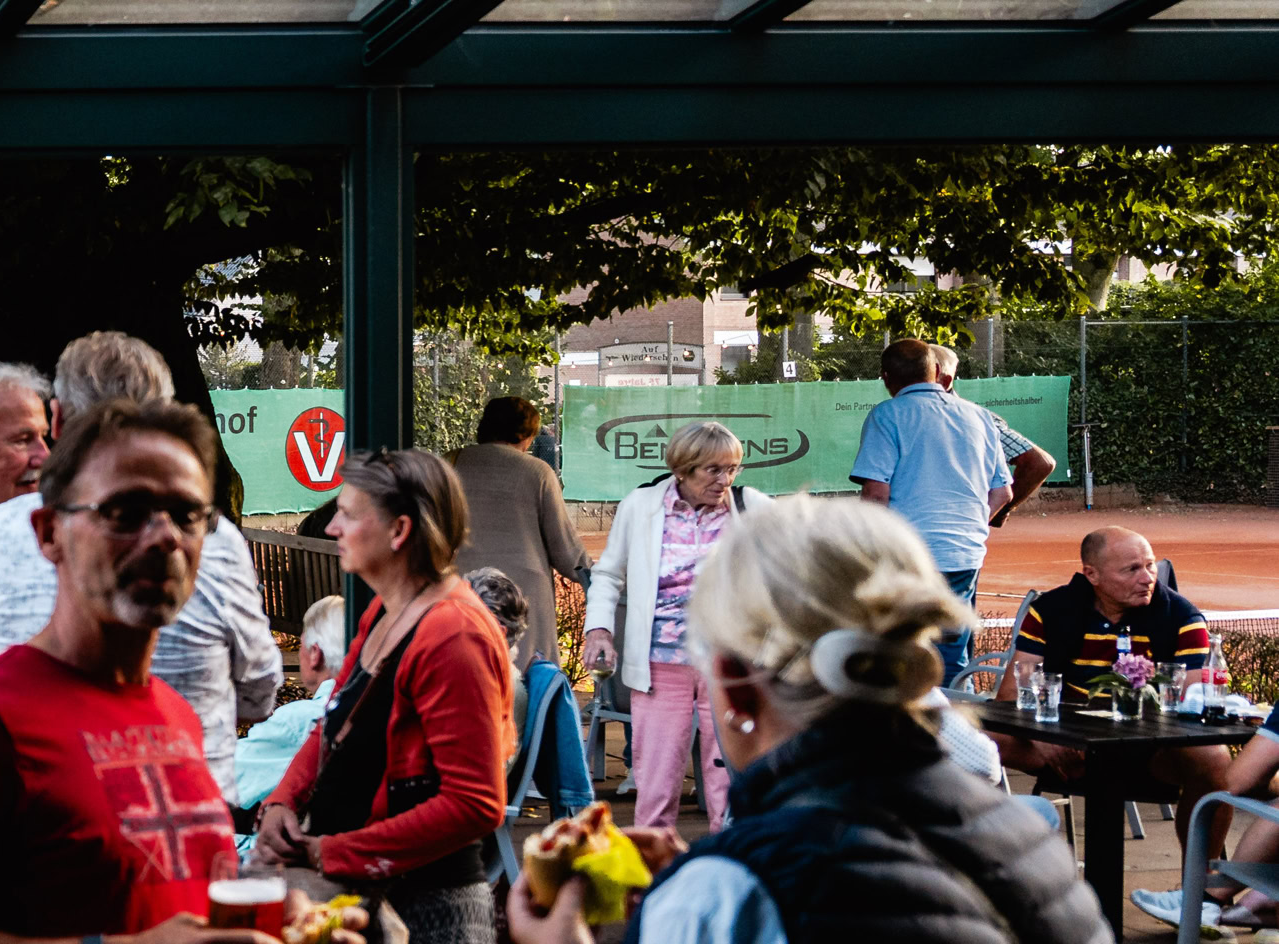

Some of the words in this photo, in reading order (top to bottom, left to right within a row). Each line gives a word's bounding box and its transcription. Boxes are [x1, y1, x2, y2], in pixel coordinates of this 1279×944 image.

[622, 353, 679, 362] Wiedrsehn
[785, 363, 794, 375] 4
[835, 402, 852, 411] Dein
